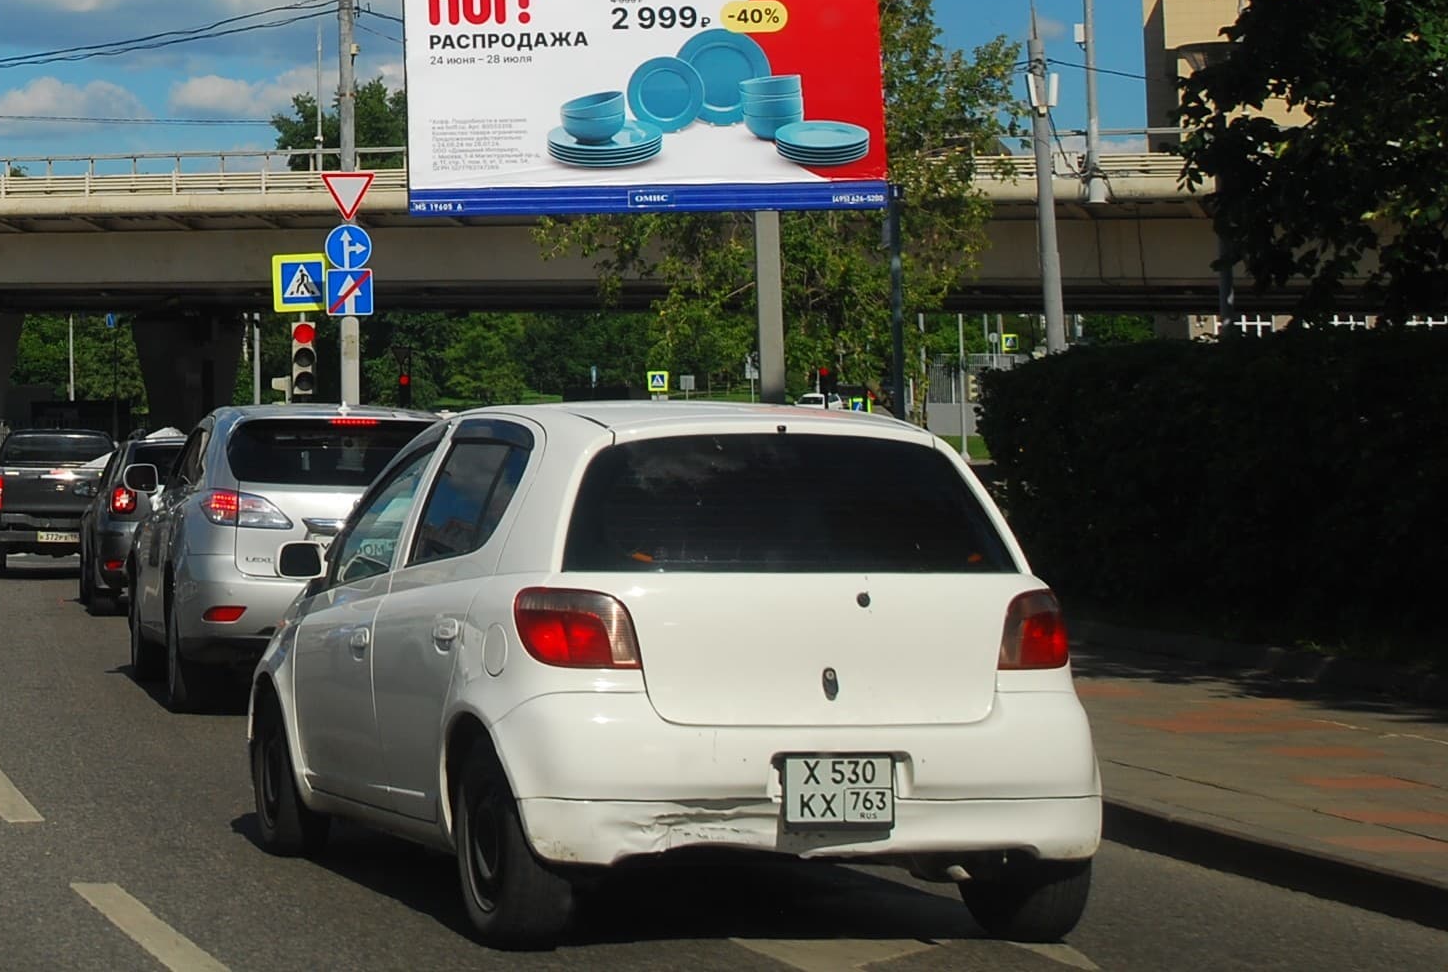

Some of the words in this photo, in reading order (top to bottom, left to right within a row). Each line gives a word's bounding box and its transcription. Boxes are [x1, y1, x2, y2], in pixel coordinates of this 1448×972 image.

[727, 8, 780, 24] -40%
[429, 31, 589, 51] РАСПРОДАЖА
[430, 56, 444, 65] 24
[446, 56, 476, 65] июня
[486, 54, 500, 64] 28
[503, 55, 532, 64] июля
[831, 760, 876, 785] 530
[850, 791, 887, 811] 763
[859, 812, 878, 820] RUS
